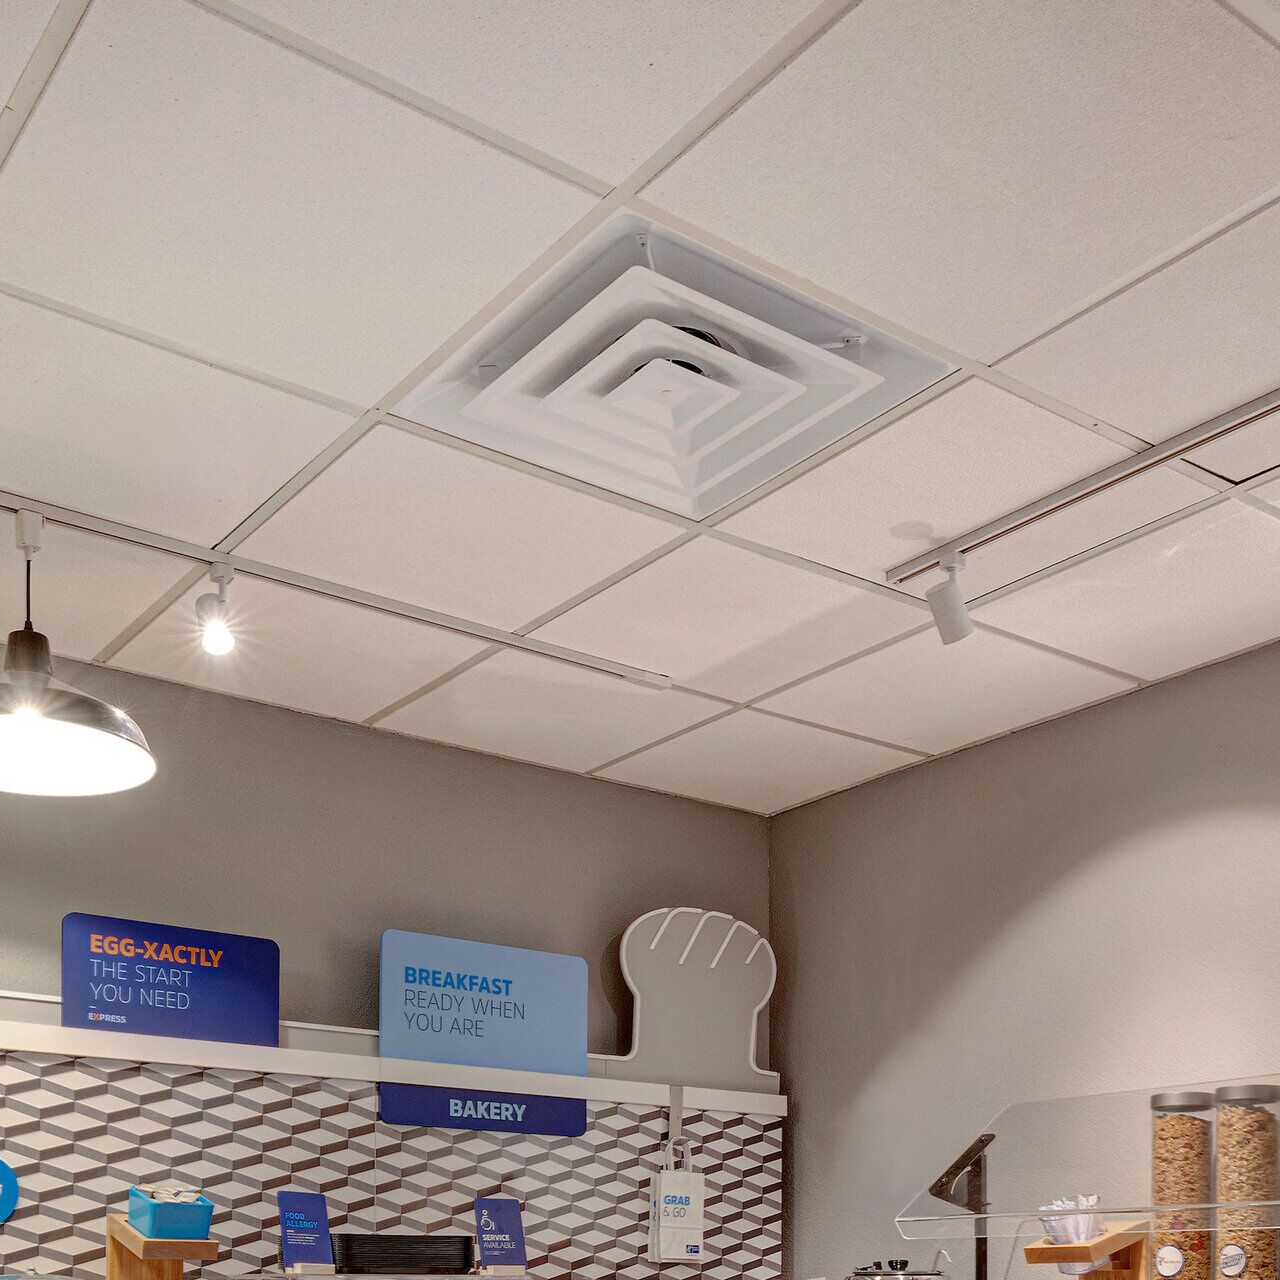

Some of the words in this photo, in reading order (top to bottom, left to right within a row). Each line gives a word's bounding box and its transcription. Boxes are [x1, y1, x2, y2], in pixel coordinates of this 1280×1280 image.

[89, 933, 224, 968] EGG-XACTLY
[89, 958, 128, 981] THE
[135, 964, 192, 988] START
[404, 966, 513, 997] BREAKFAST
[89, 982, 132, 1004] YOU
[140, 988, 190, 1010] NEED
[404, 988, 465, 1013] READY
[471, 997, 526, 1020] WHEN
[87, 1012, 127, 1024] EXPRESS
[403, 1011, 443, 1034] YOU
[449, 1017, 485, 1038] ARE
[449, 1098, 527, 1122] BAKERY
[664, 1195, 691, 1206] GRAB
[673, 1206, 687, 1218] GO
[285, 1212, 305, 1220] FOOD
[286, 1220, 318, 1229] ALLERGY
[483, 1241, 517, 1249] AVAILABLE
